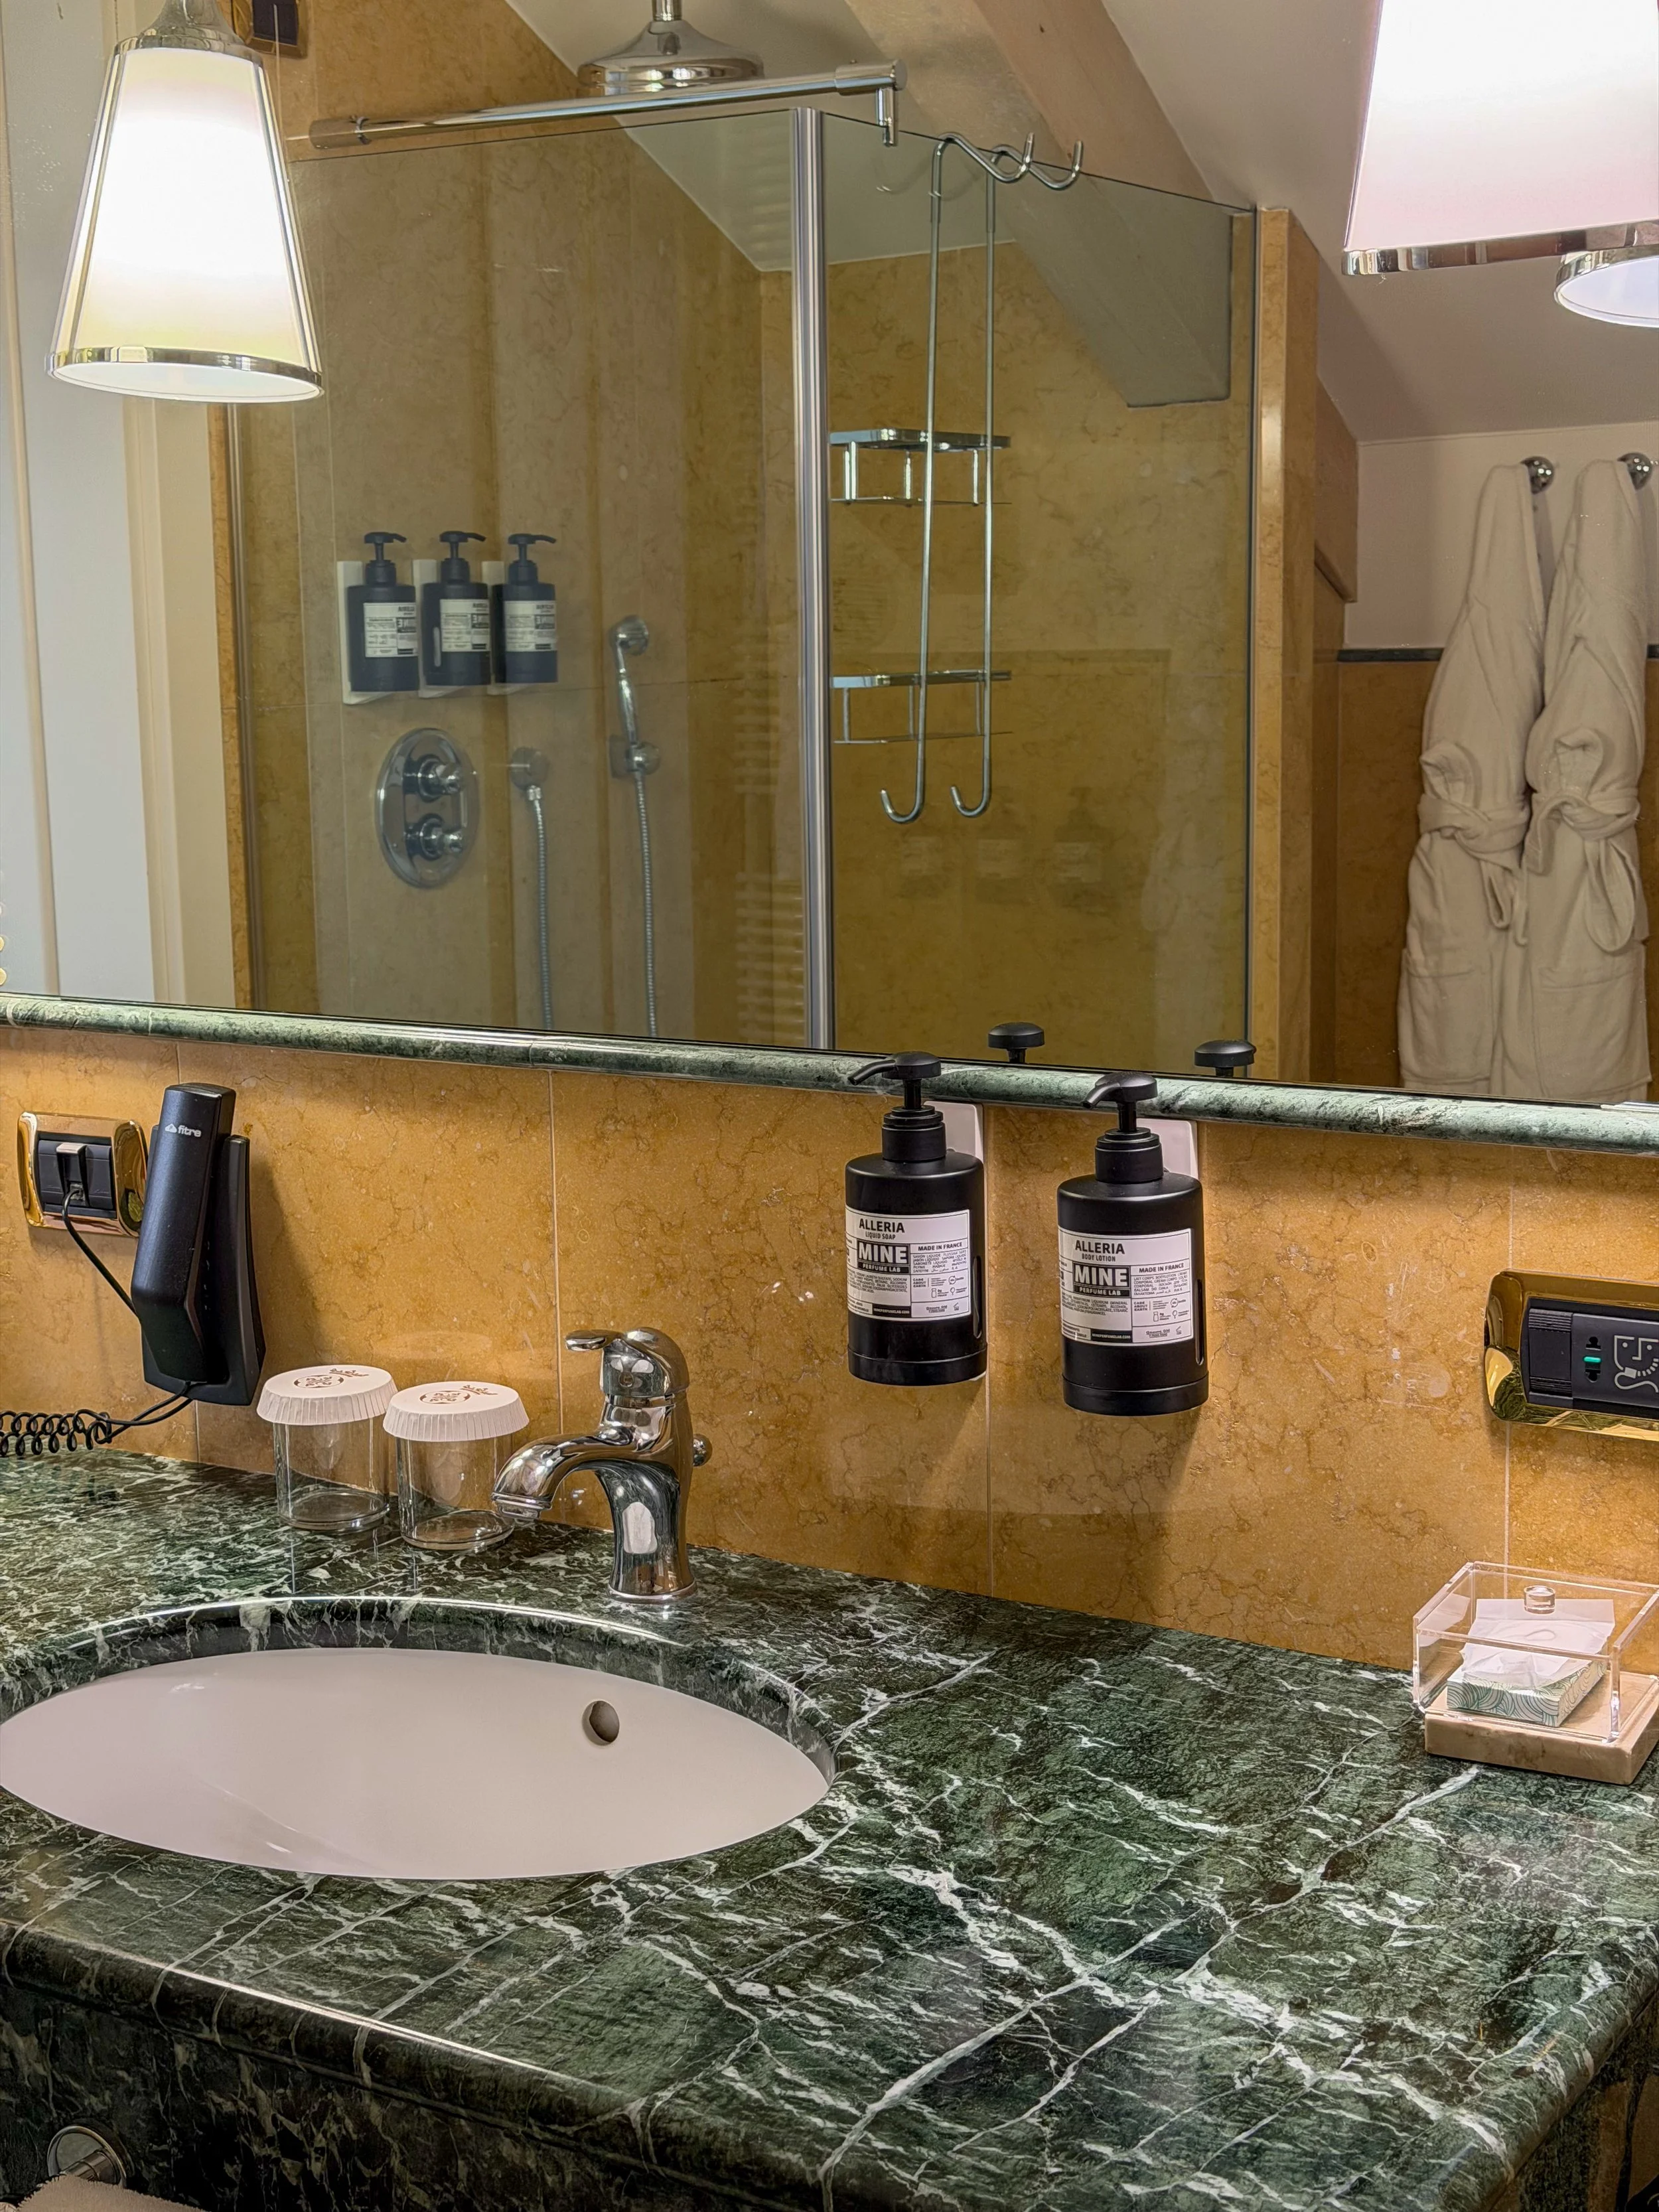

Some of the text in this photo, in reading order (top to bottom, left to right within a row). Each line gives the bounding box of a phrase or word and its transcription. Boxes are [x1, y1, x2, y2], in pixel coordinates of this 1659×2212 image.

[178, 1125, 202, 1138] fitre
[859, 1218, 905, 1233] ALLERIA
[865, 1231, 881, 1240] LIQUID
[859, 1242, 908, 1264] MINE
[1075, 1240, 1125, 1254] ALLERIA
[1075, 1265, 1127, 1287] MINE
